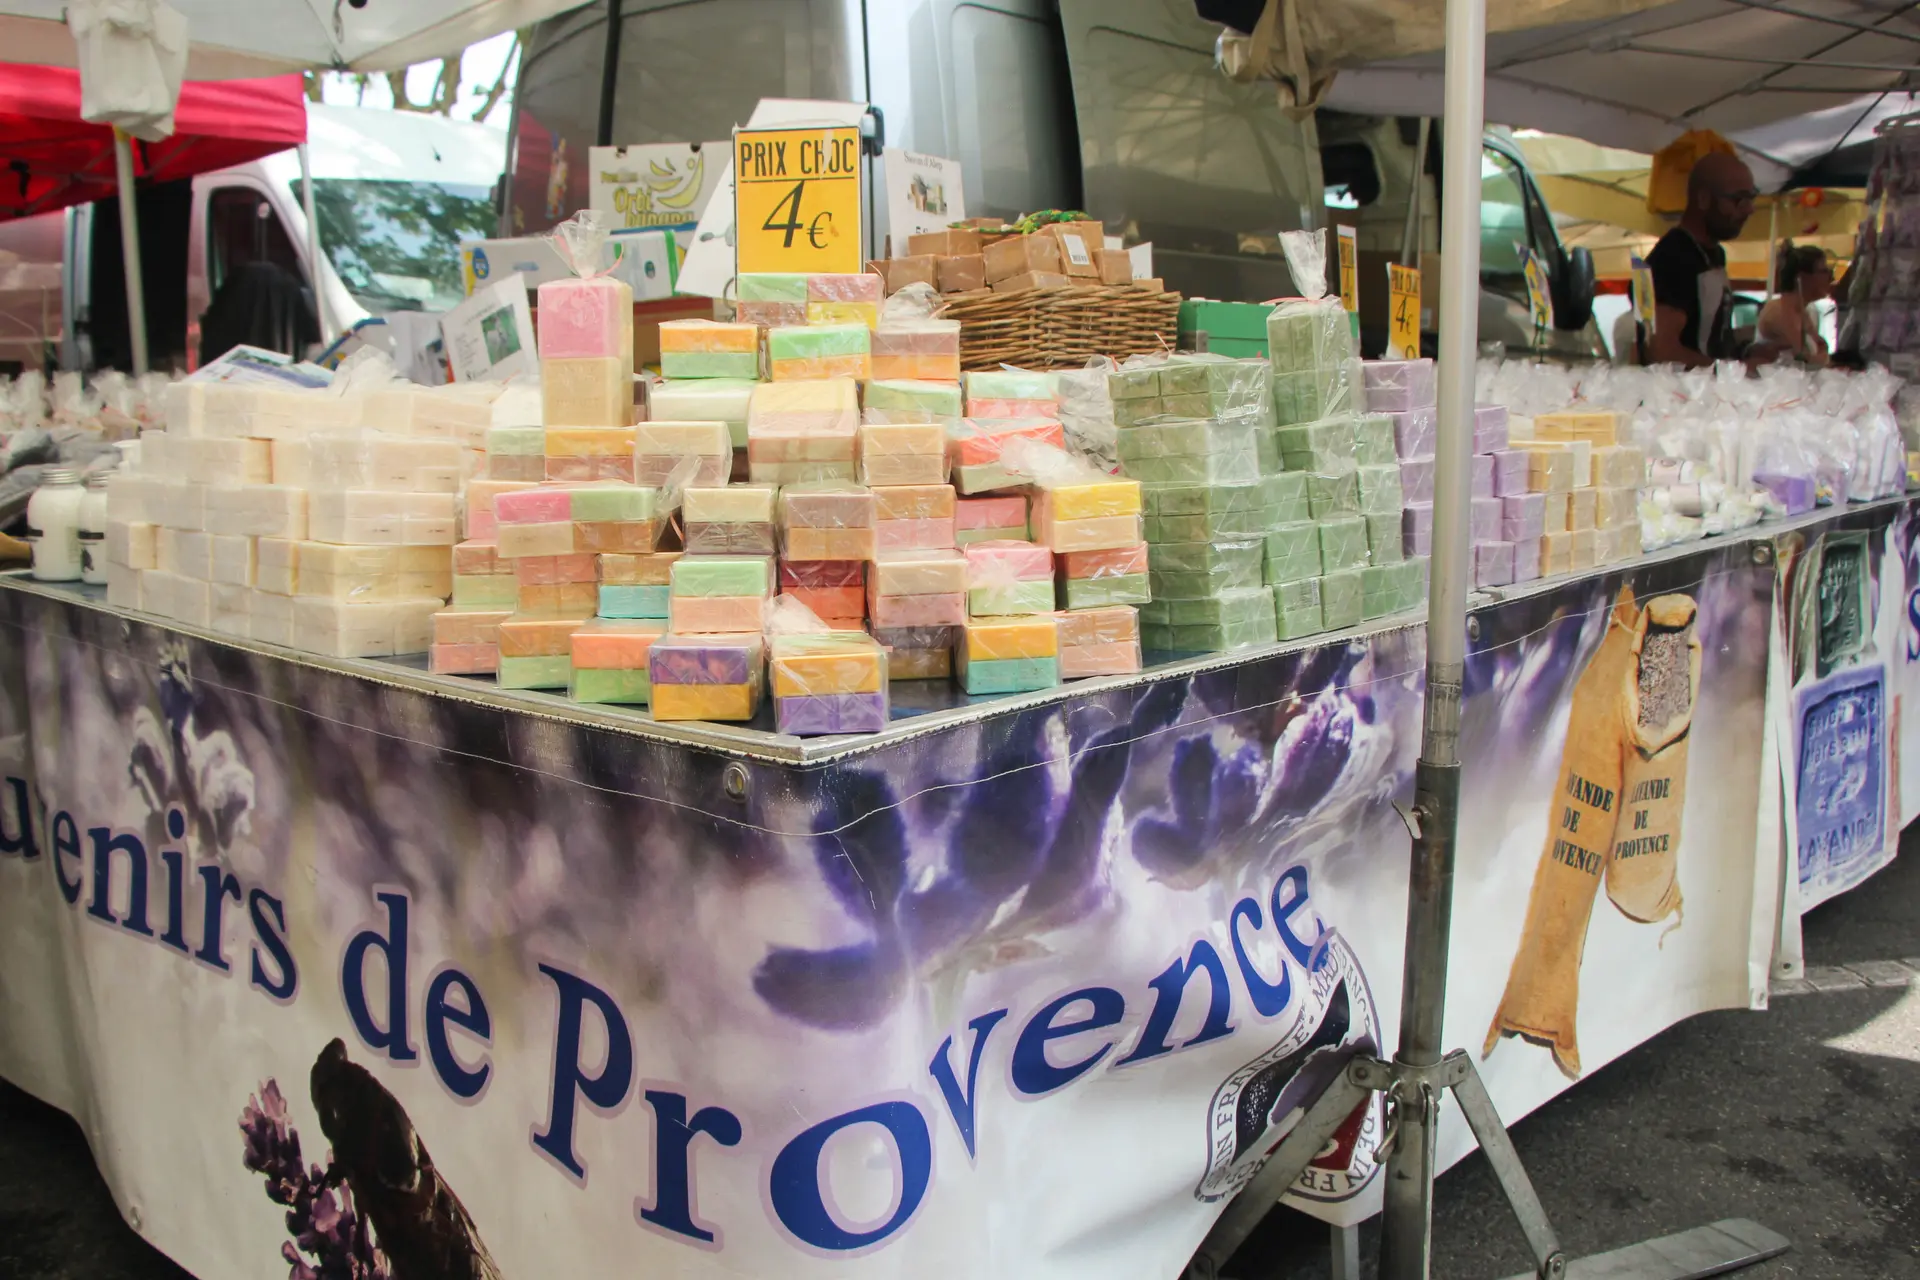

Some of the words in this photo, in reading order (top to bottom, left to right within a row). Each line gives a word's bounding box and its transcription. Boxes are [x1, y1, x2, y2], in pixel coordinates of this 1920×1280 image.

[740, 140, 787, 177] PRIX
[800, 137, 854, 174] CHOC
[761, 180, 833, 248] 4€
[1563, 805, 1581, 833] DE
[1633, 809, 1648, 831] DE
[1614, 833, 1670, 861] PROVENCE
[0, 776, 297, 999] uenirs
[343, 892, 491, 1098] de
[533, 865, 1329, 1250] Provence
[1216, 1022, 1310, 1131] FRANCE
